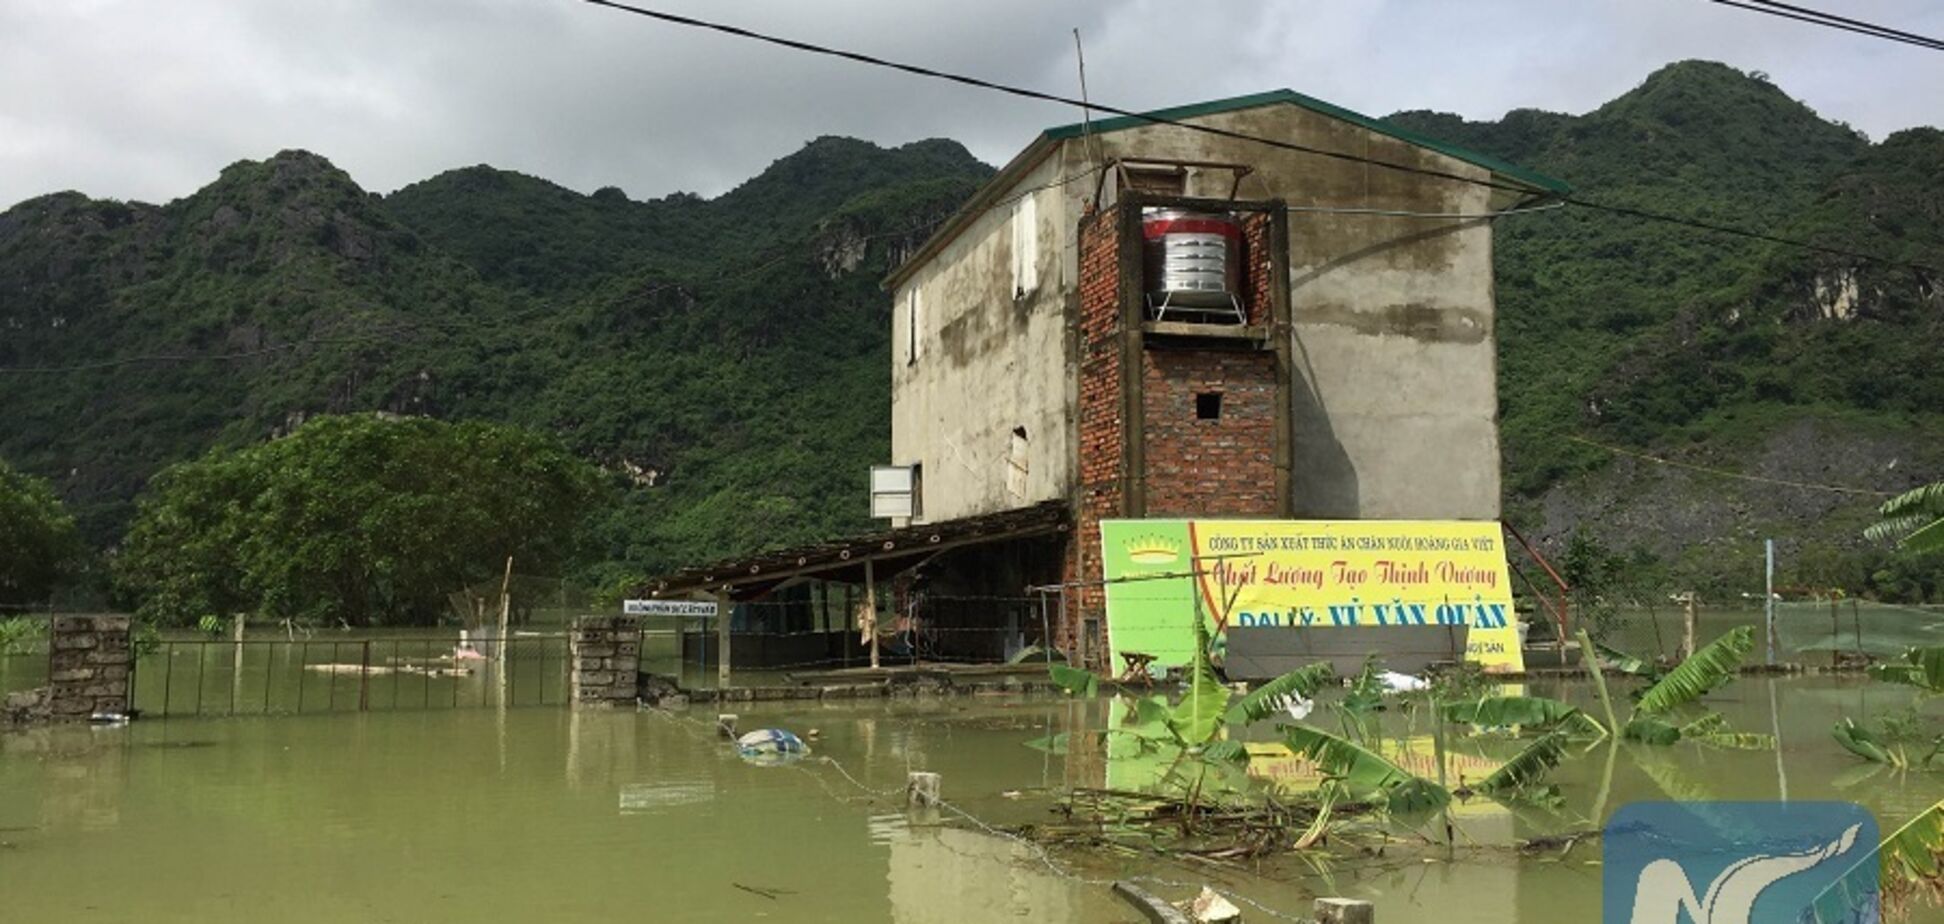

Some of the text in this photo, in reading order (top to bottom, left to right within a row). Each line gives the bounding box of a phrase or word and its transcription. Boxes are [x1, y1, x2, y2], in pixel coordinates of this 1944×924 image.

[1209, 534, 1238, 550] CÔNG
[1240, 537, 1254, 550] TY
[1257, 533, 1277, 550] SẢN
[1280, 533, 1309, 550] XUẤT
[1311, 534, 1338, 550] THỨC
[1341, 535, 1355, 550] ĂN
[1356, 535, 1385, 550] CHĂN
[1452, 538, 1469, 550] GIA
[1472, 535, 1494, 551] VIỆT
[1213, 560, 1497, 590] Chất Lượng Tạo Thịnh Vượng
